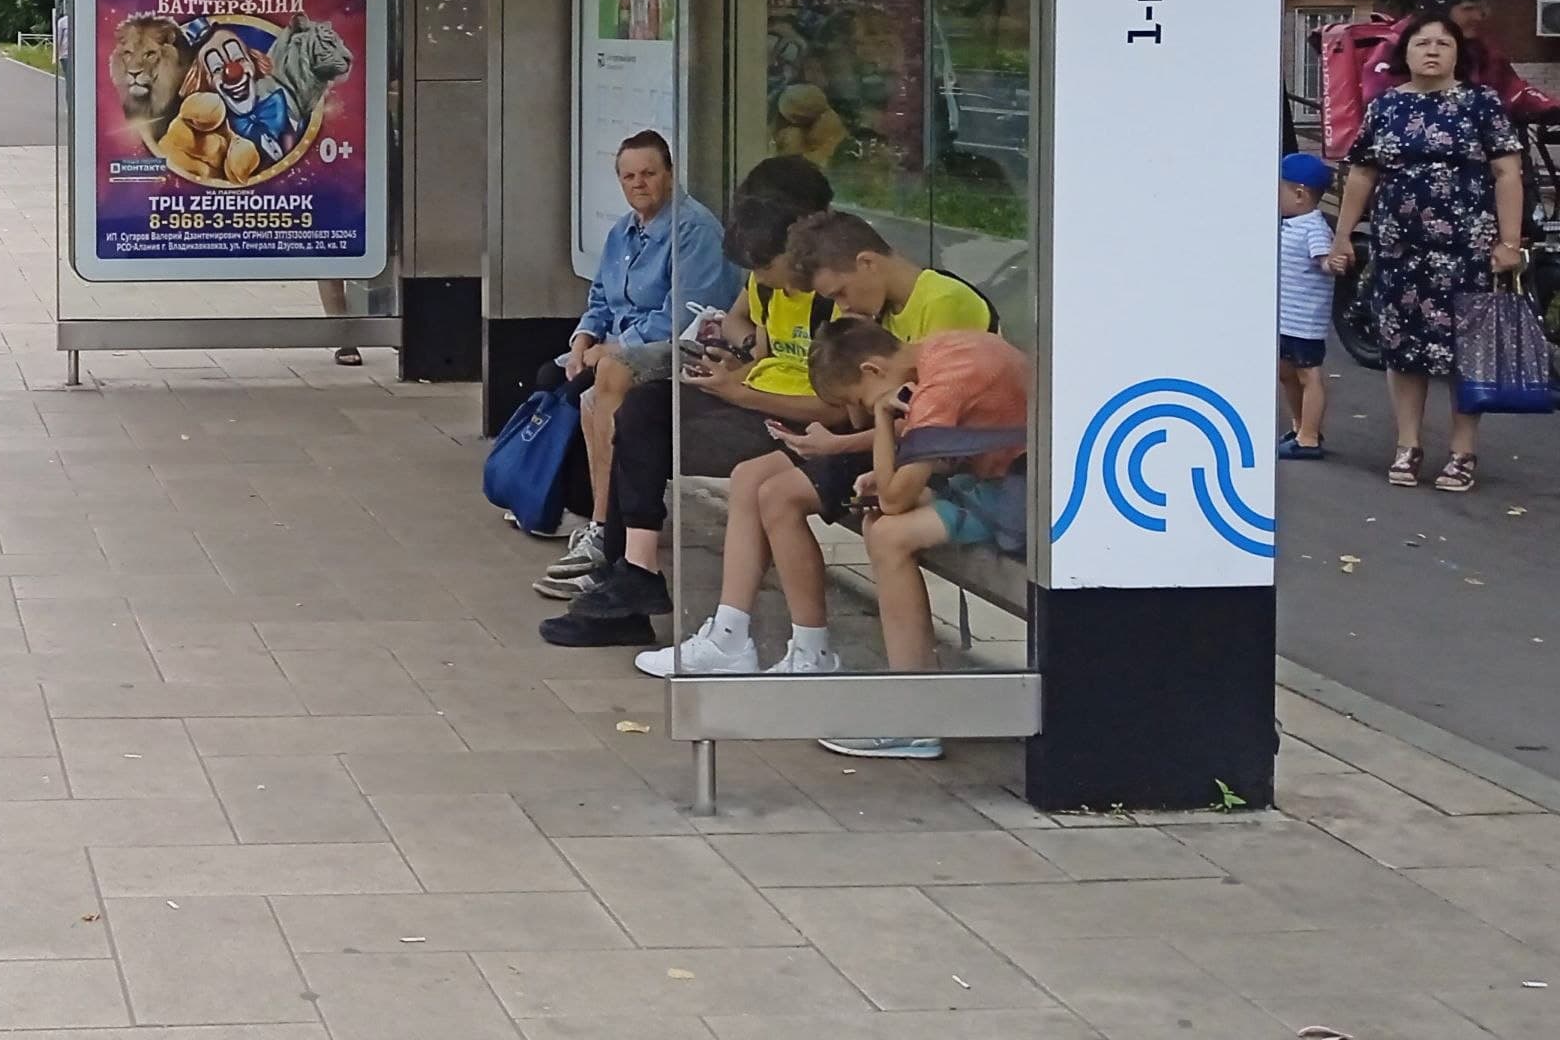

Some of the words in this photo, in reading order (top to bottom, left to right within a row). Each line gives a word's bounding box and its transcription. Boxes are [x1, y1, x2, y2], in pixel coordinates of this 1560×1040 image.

[318, 136, 354, 164] 0+
[148, 195, 185, 214] ТРЦ
[189, 194, 313, 212] ZЕЛЕНОПАРК
[149, 212, 313, 230] 8-968-3-55555-9
[120, 232, 150, 243] Сугаров
[151, 230, 183, 241] Валерий
[242, 230, 273, 240] ОГРНИП
[116, 242, 161, 252] РСО-Алания
[340, 240, 347, 250] 12
